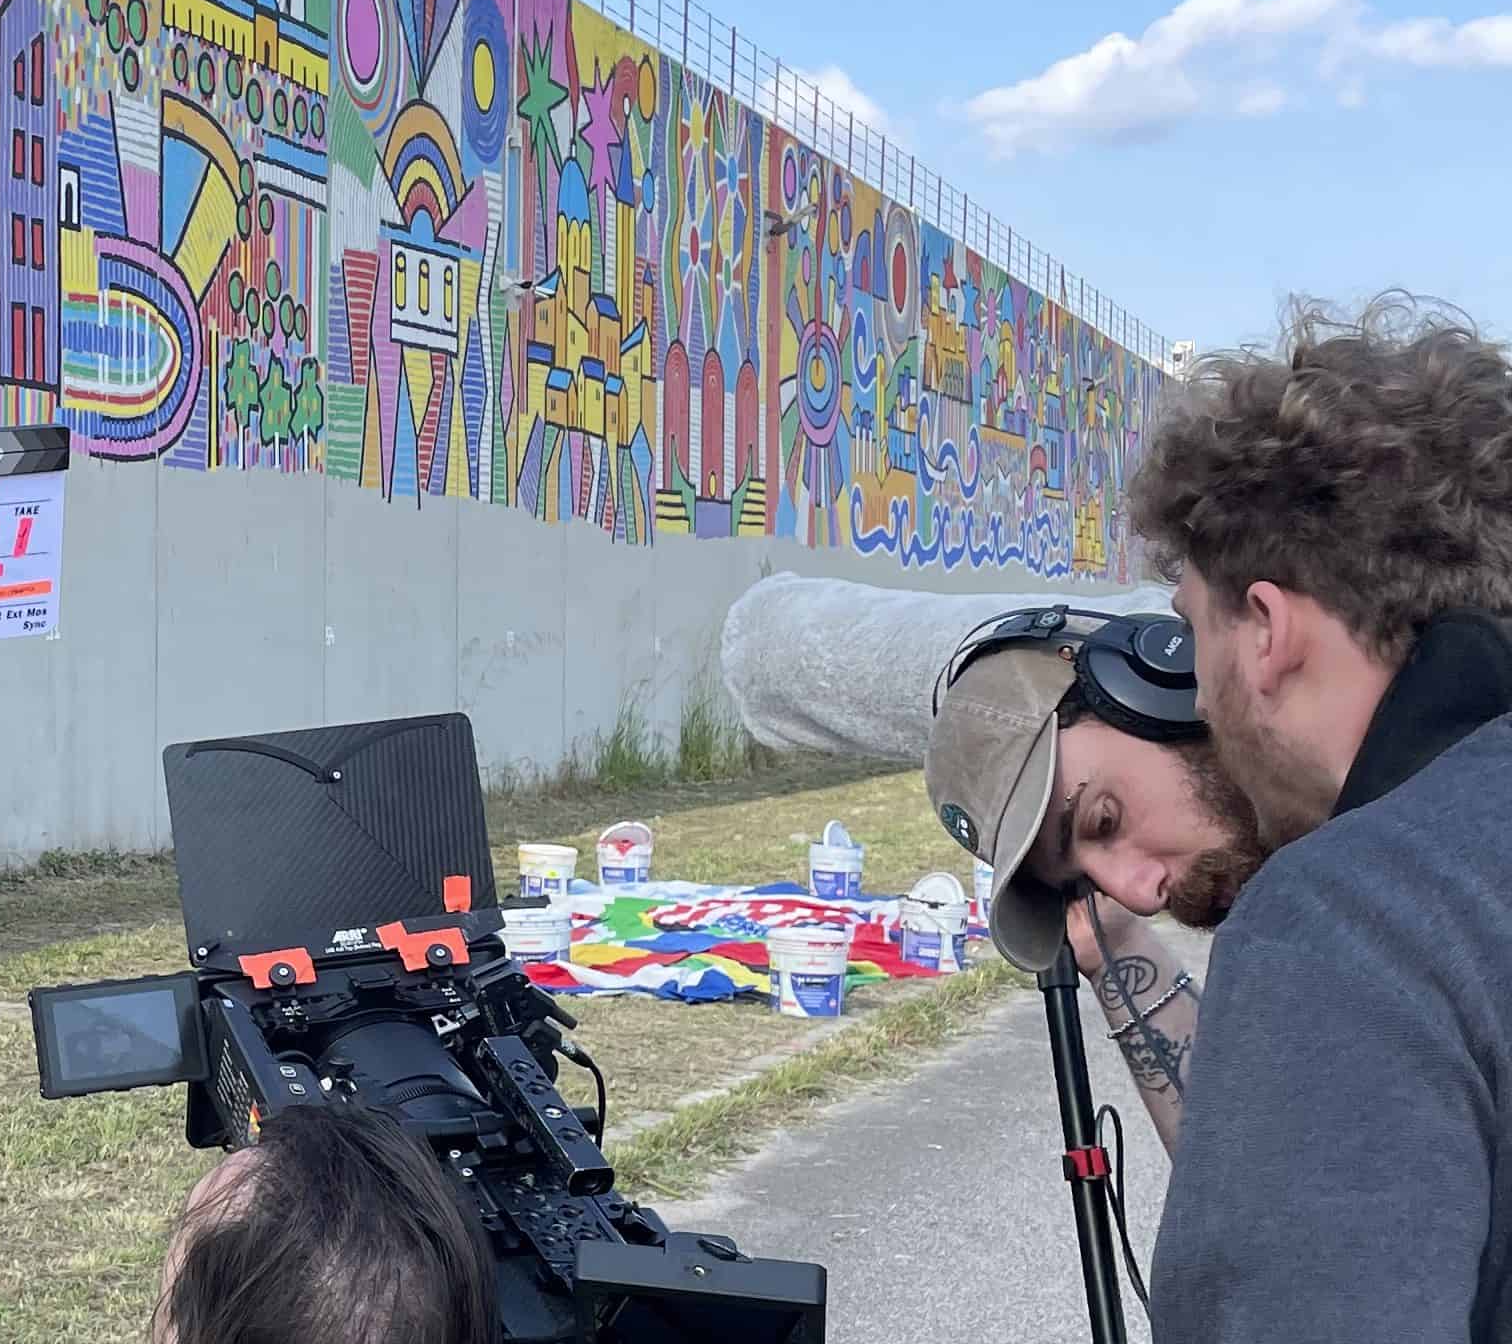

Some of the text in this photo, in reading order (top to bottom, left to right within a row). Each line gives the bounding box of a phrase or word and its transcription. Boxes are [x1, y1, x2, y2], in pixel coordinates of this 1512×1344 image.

[14, 505, 41, 516] TAKE
[6, 609, 23, 620] Ext
[23, 620, 47, 632] Sync
[1164, 636, 1183, 657] AKG
